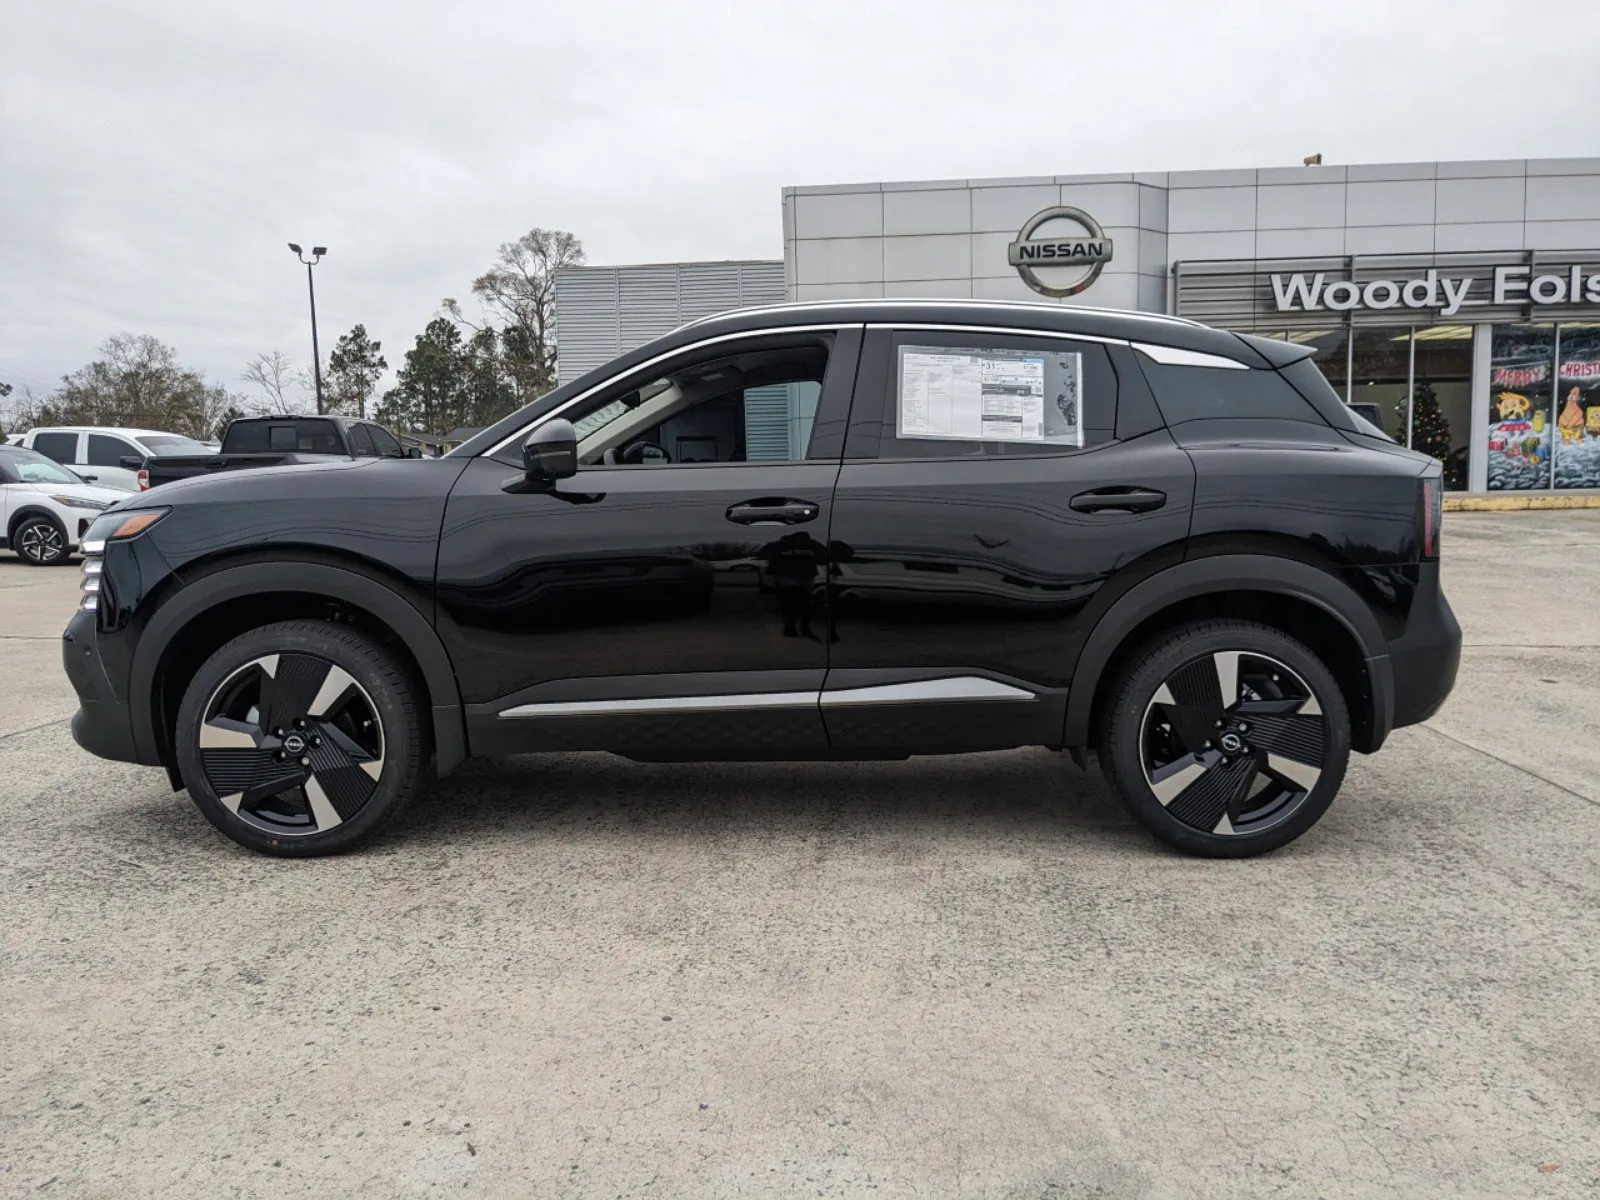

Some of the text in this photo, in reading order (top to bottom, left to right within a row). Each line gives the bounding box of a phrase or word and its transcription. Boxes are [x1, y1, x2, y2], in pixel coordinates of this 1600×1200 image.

[1020, 242, 1103, 259] NISSAN
[1270, 269, 1474, 315] Woody
[1495, 362, 1600, 383] MERRY CHRIST
